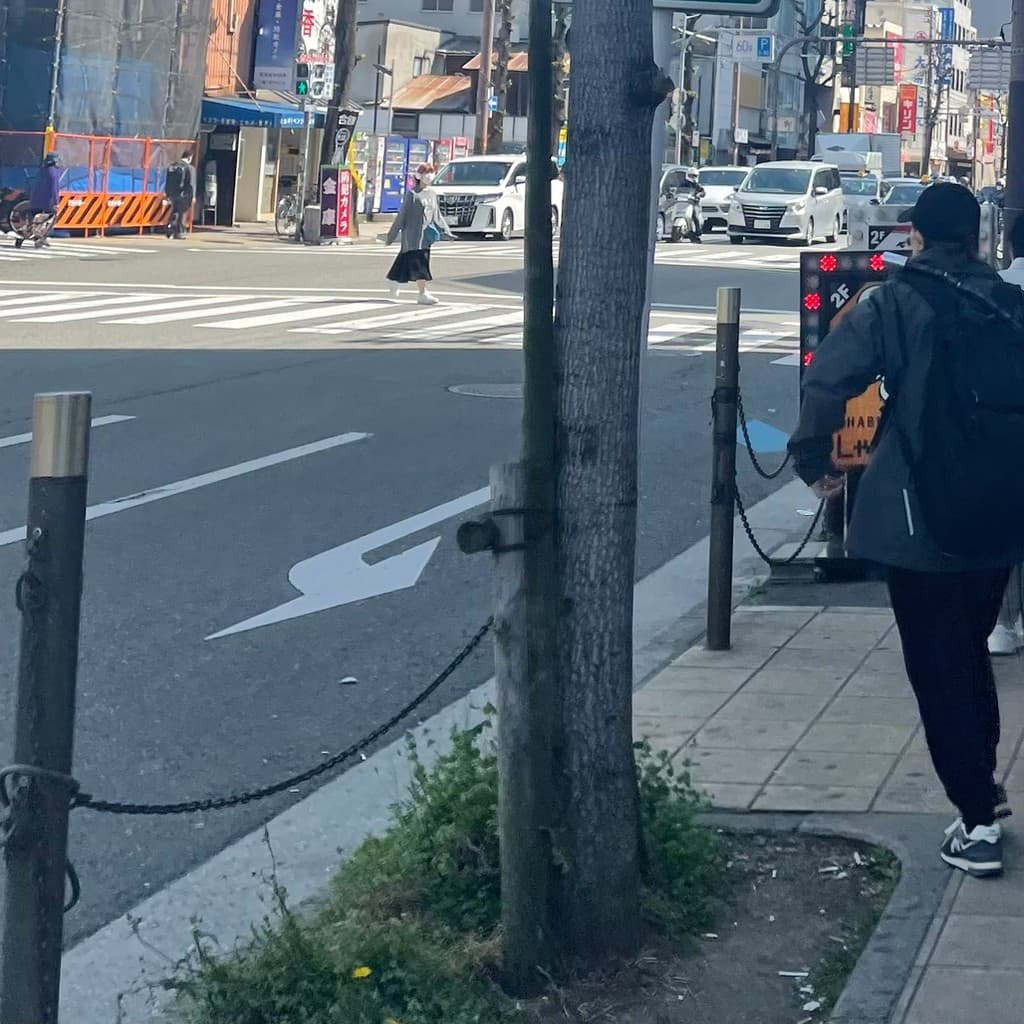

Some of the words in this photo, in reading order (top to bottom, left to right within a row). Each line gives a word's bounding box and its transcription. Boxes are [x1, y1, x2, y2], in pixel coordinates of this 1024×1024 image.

[340, 171, 351, 233] 防犯カメラ
[871, 230, 885, 245] 2F
[830, 283, 850, 309] 2F
[847, 416, 879, 428] HAB
